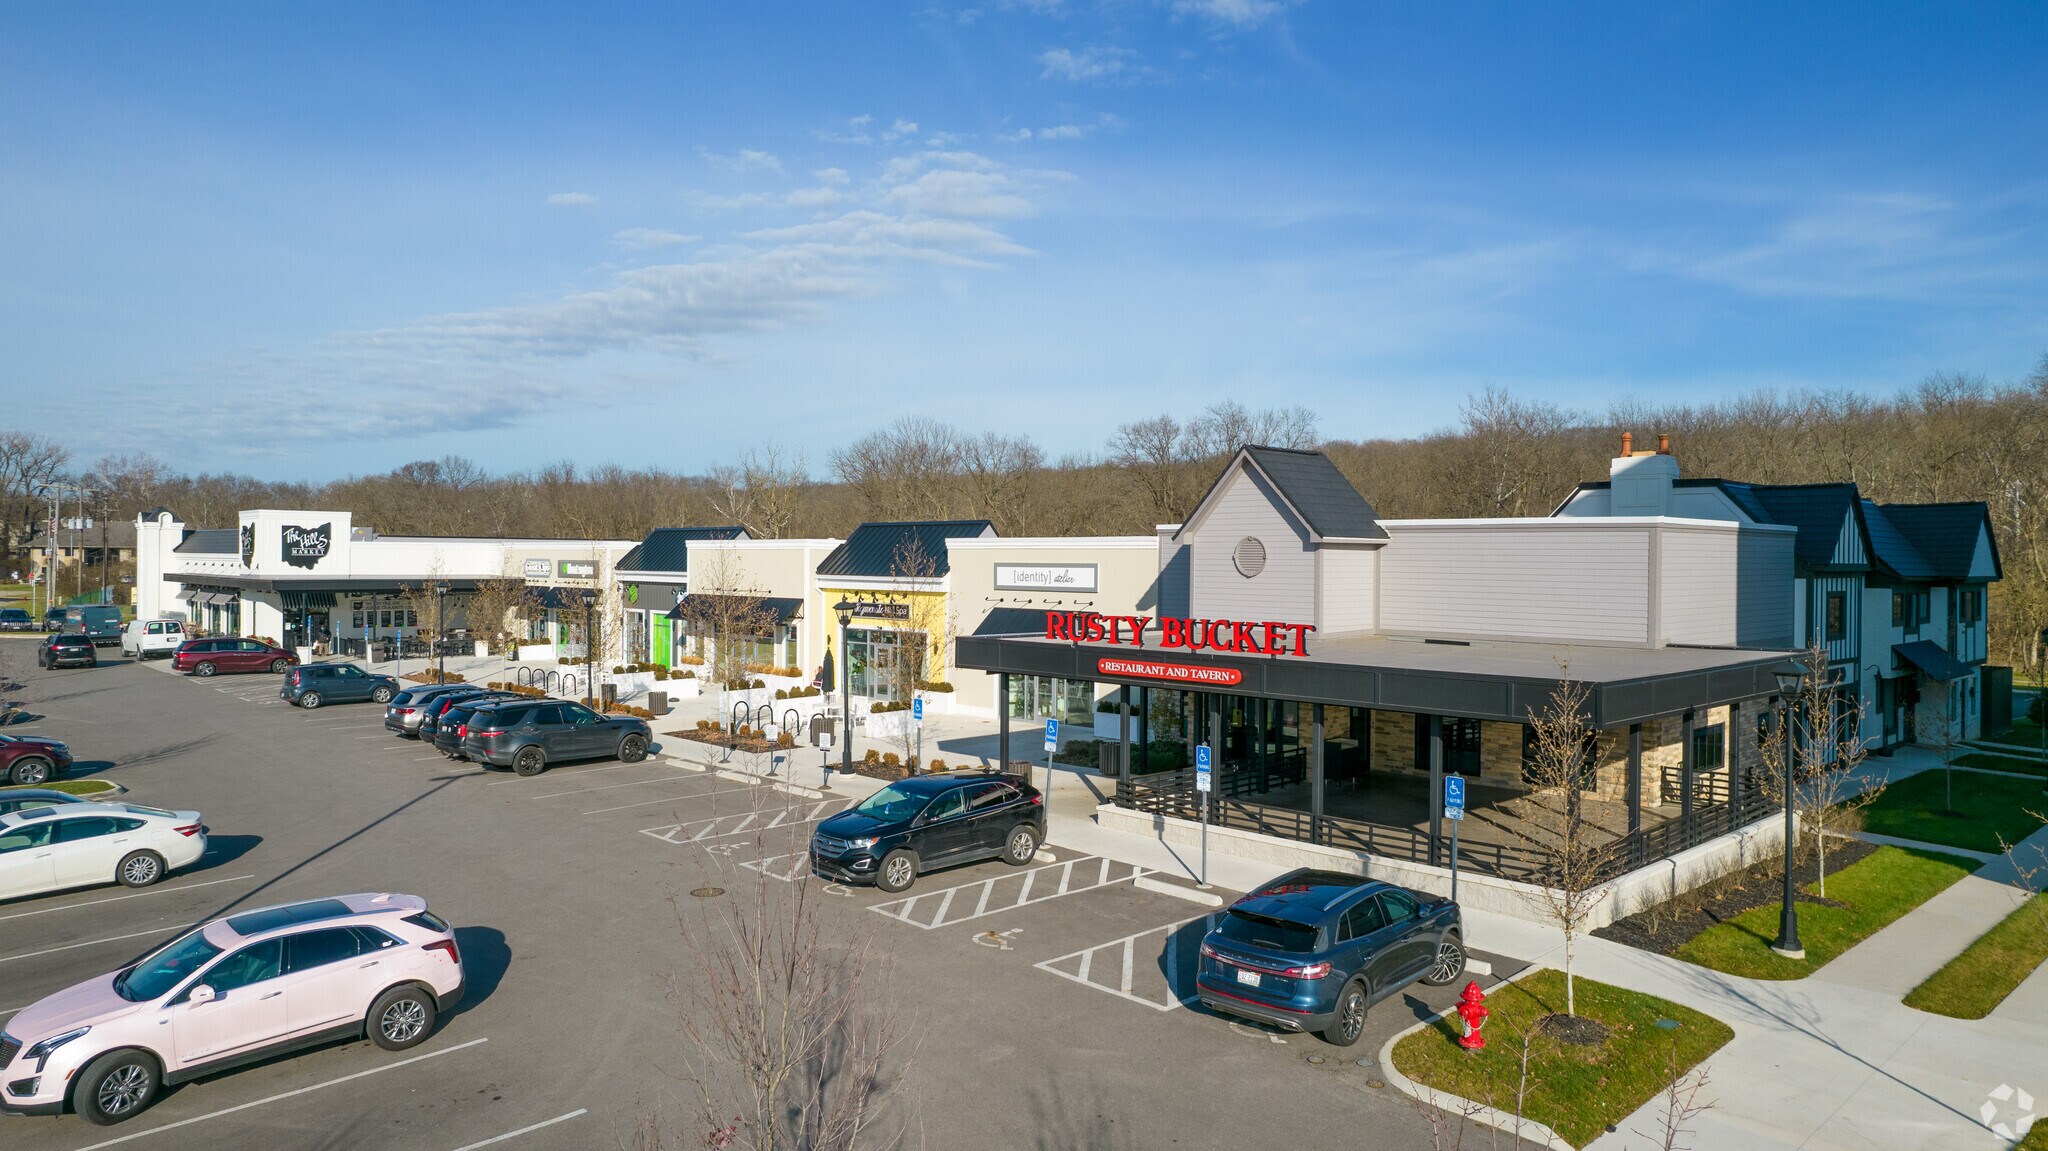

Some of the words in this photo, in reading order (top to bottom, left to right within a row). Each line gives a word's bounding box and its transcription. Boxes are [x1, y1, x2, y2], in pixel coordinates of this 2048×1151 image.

[283, 528, 301, 544] The
[300, 531, 328, 550] Hills
[1053, 569, 1075, 583] atelier
[896, 606, 907, 615] Spa
[1045, 611, 1152, 646] RUSTY
[1159, 616, 1317, 657] BUCKET
[1104, 661, 1165, 677] RESTAURANT
[1166, 667, 1188, 678] AND
[1190, 669, 1230, 682] TAVERN
